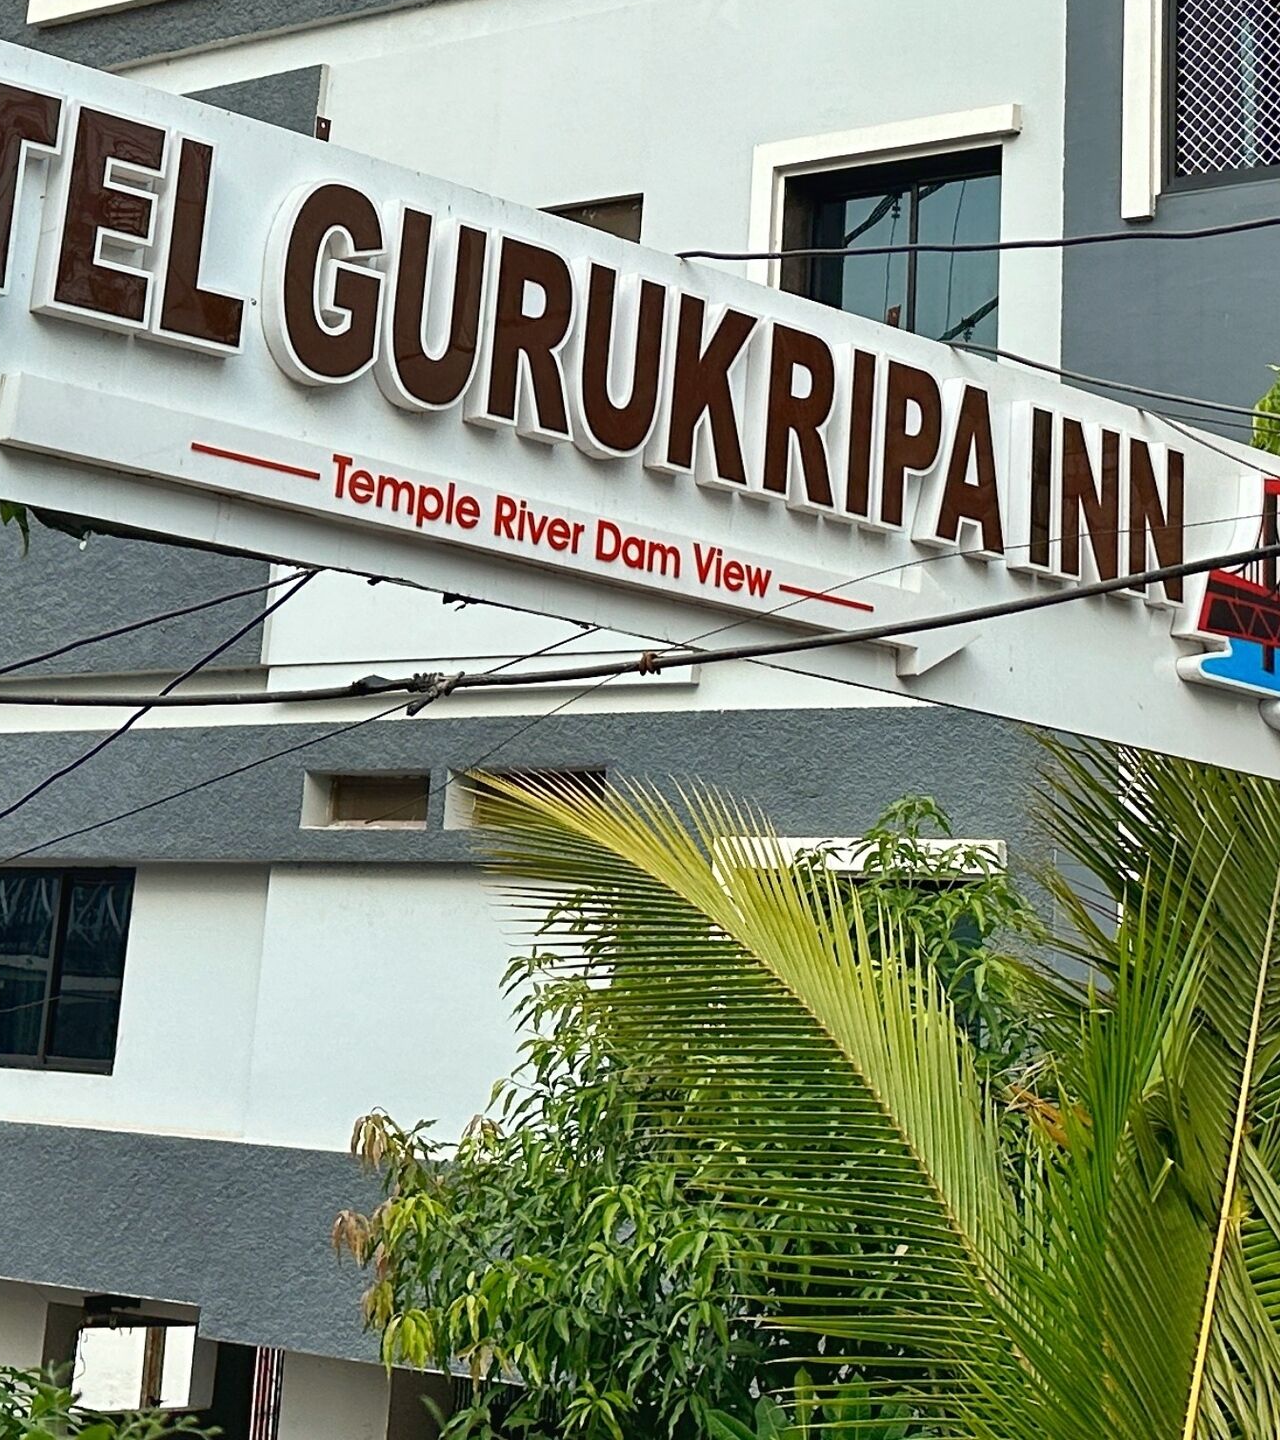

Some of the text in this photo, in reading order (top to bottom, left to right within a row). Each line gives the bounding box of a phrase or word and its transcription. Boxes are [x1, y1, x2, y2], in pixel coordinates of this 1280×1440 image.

[282, 182, 1006, 558] GURUKRIPA
[1024, 405, 1185, 605] INN
[332, 453, 773, 598] Temple River Dam View
